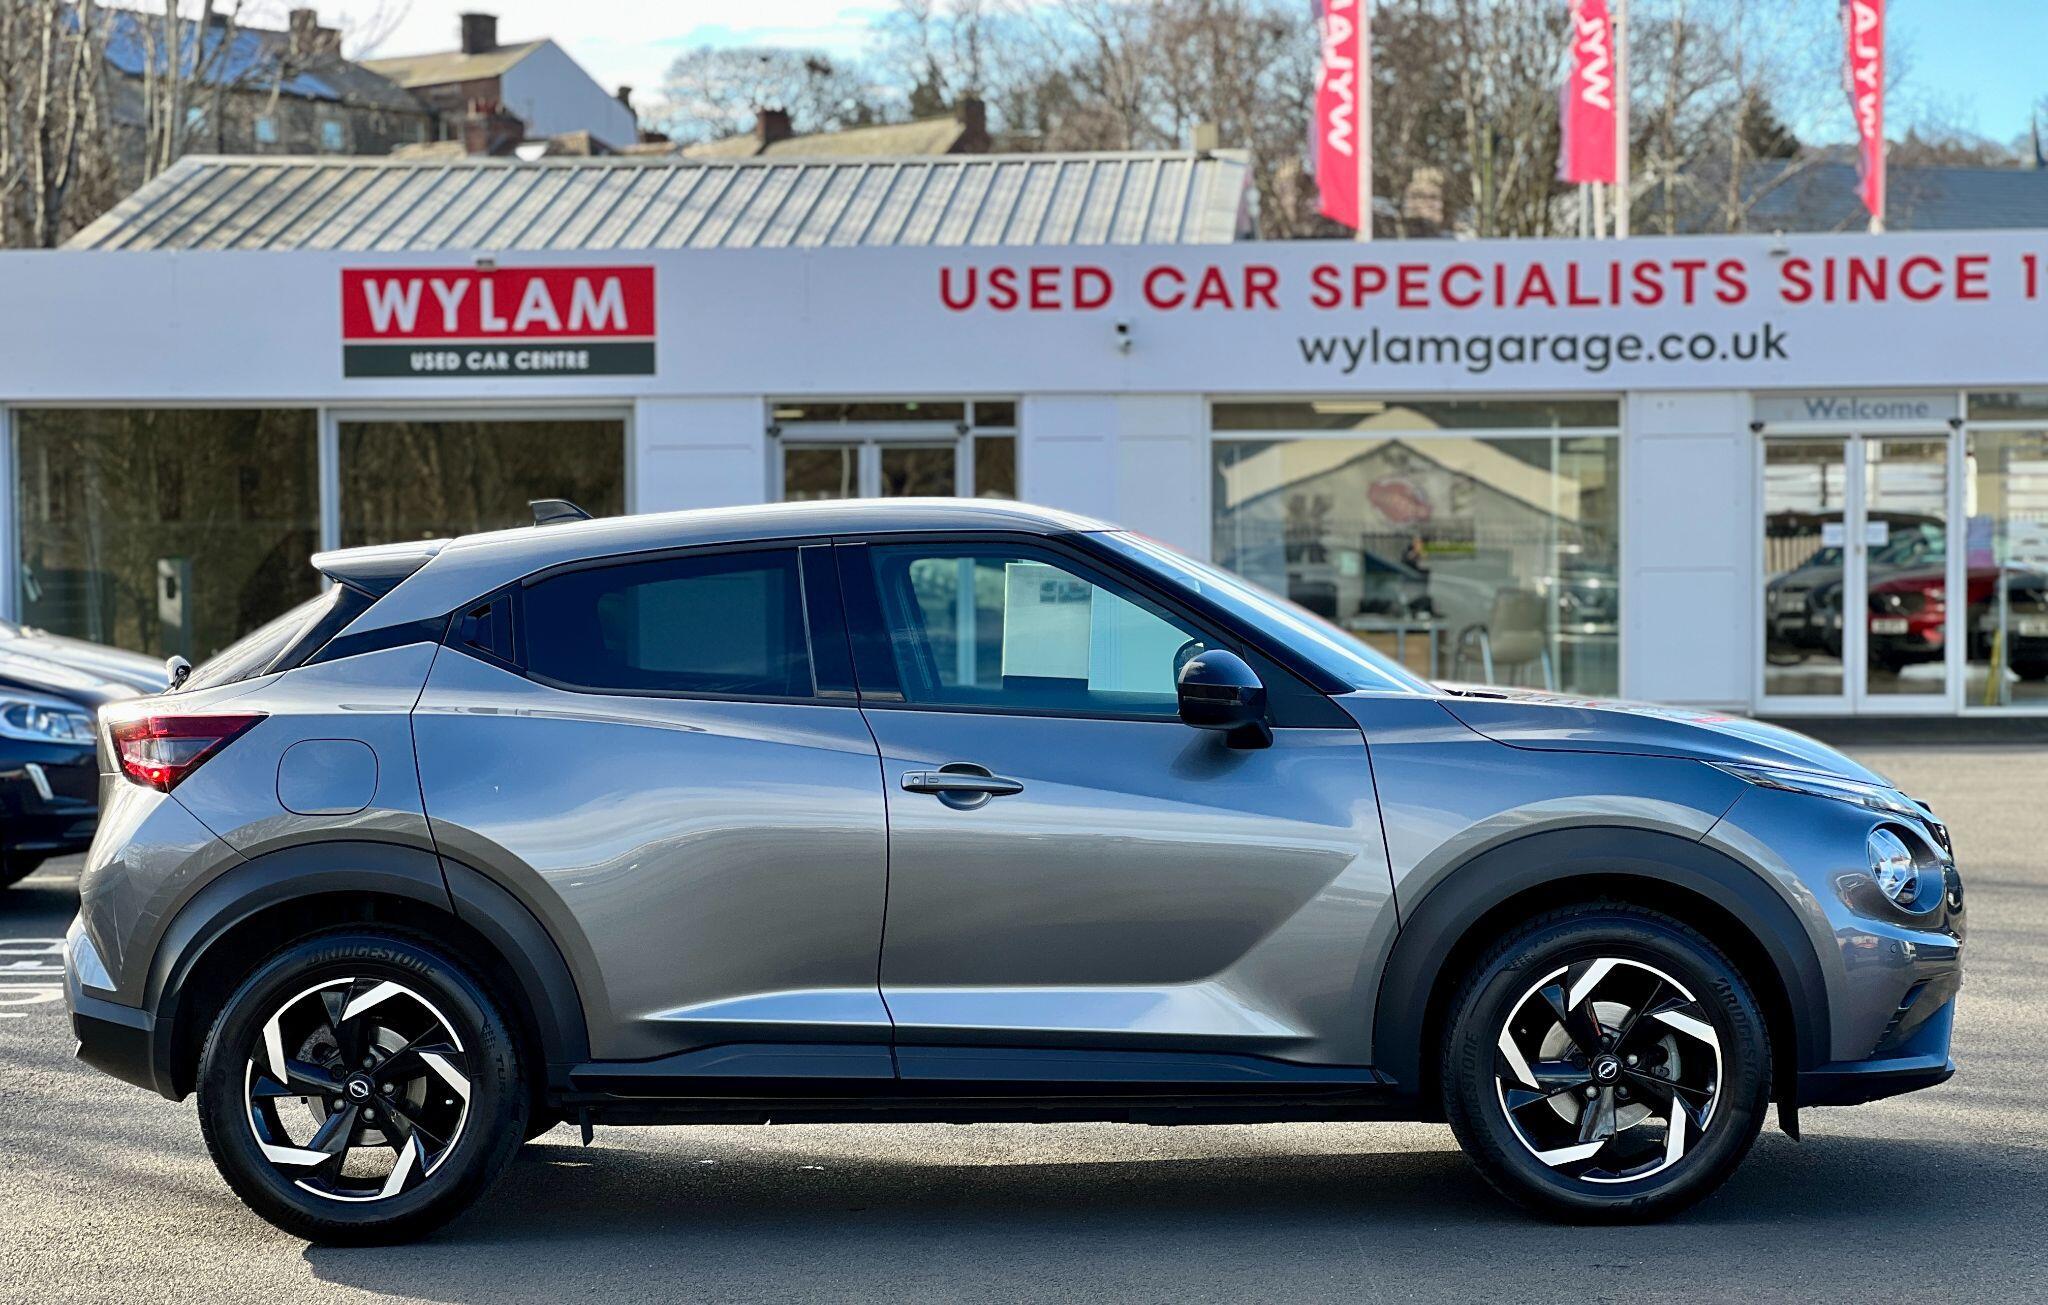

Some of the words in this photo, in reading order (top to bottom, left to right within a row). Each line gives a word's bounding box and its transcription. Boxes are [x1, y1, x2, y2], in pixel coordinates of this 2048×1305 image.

[363, 276, 629, 332] WYLAM
[940, 266, 1114, 312] USED
[1142, 265, 1279, 310] CAR
[1311, 259, 1748, 309] SPECIALISTS
[1780, 255, 1990, 304] SINCE
[410, 351, 461, 371] USED
[465, 351, 510, 371] CAR
[514, 350, 589, 370] CENTRE
[1299, 323, 1788, 374] wylamgarage.co.uk
[1803, 396, 1929, 419] Welcome
